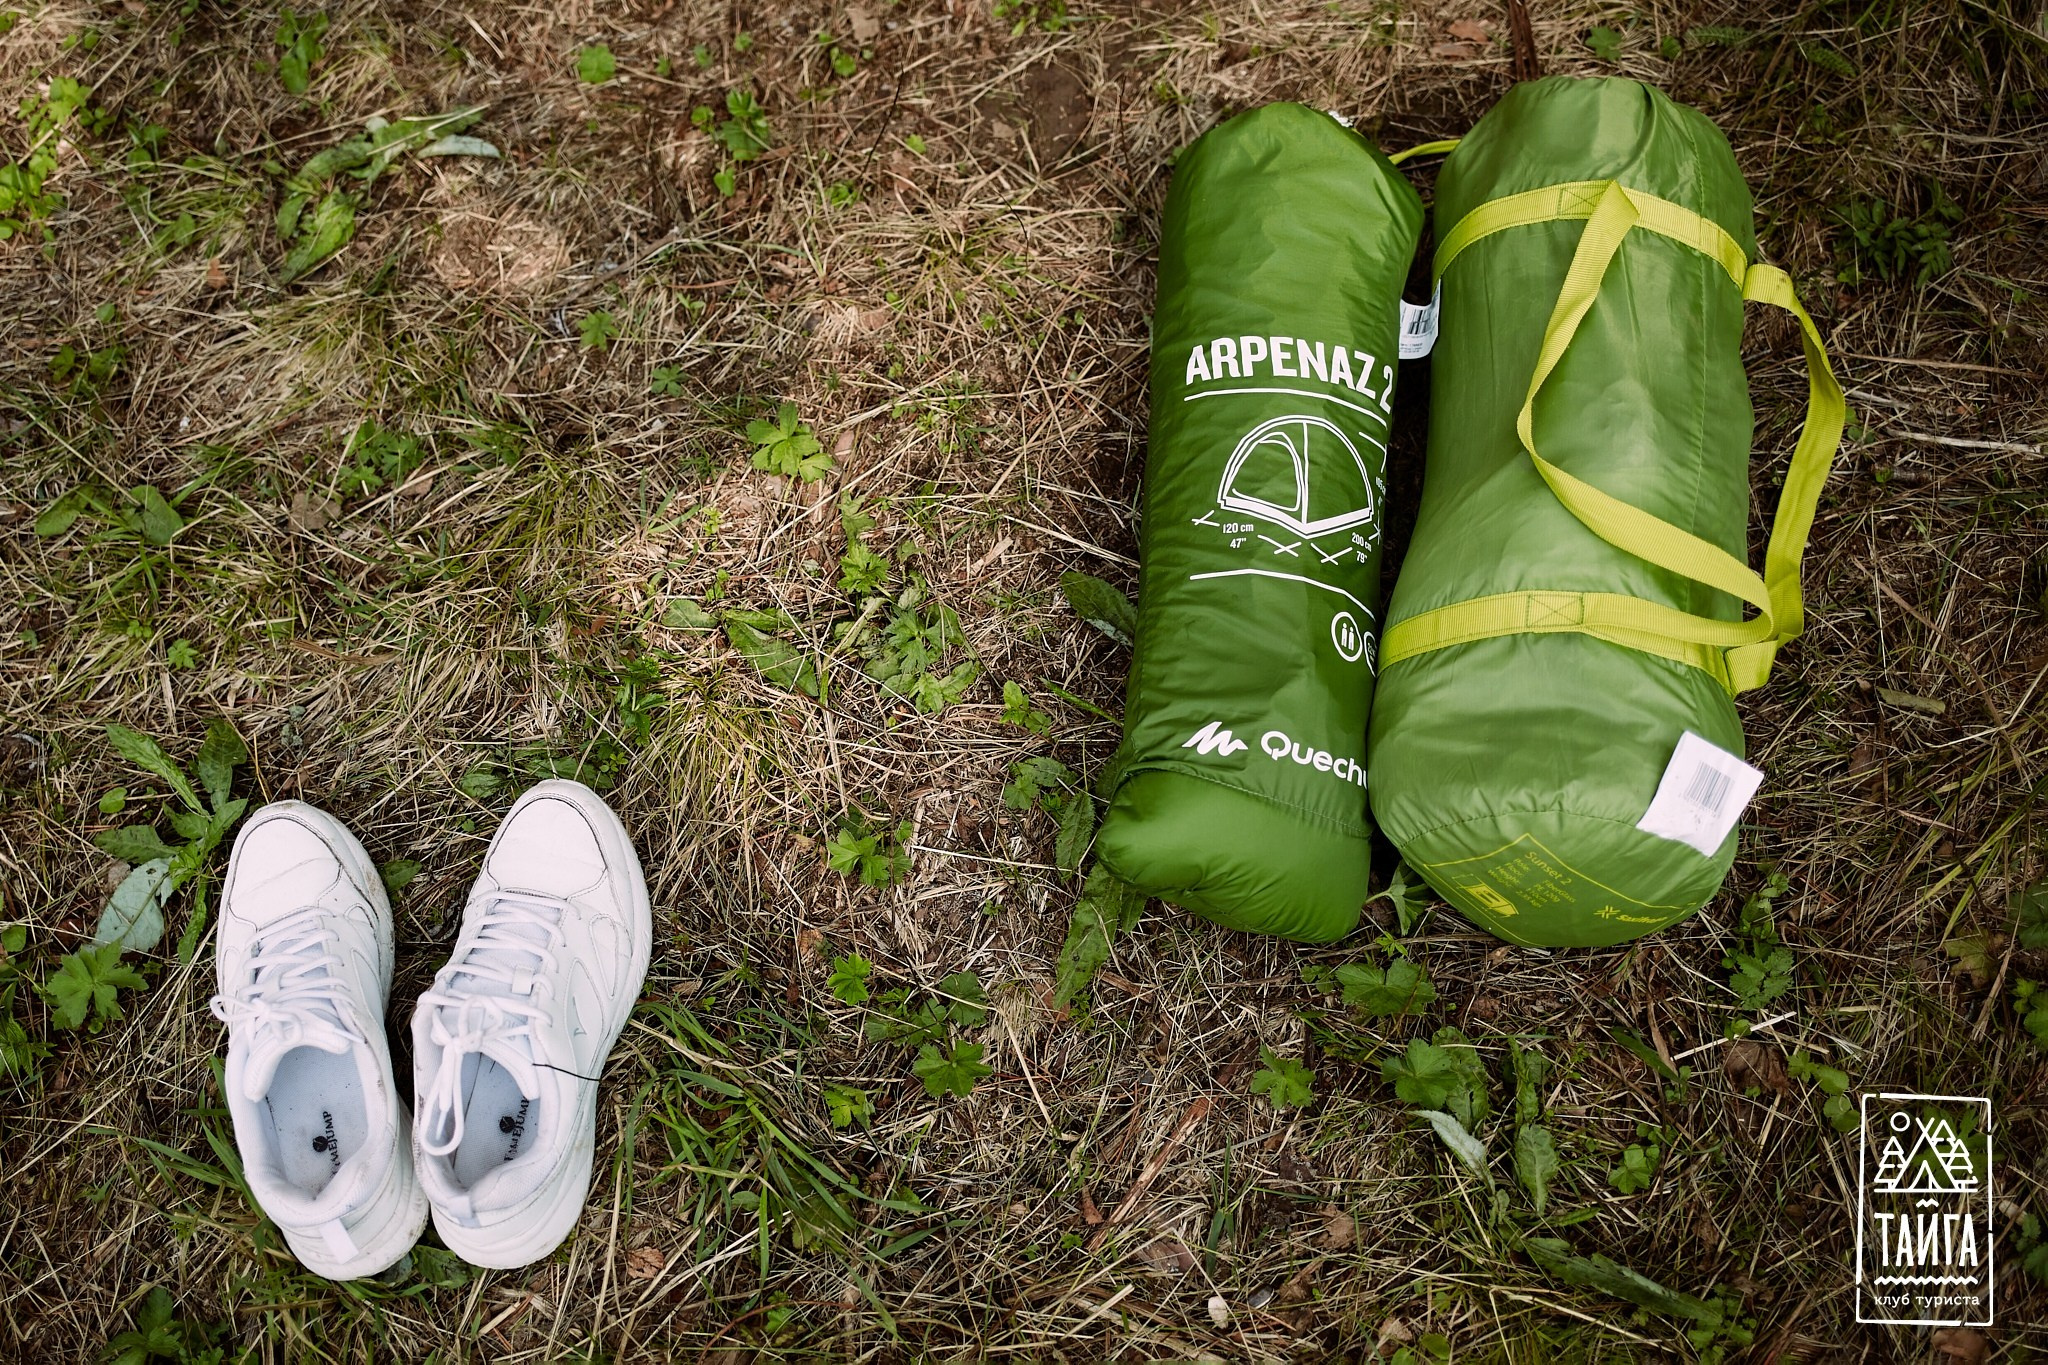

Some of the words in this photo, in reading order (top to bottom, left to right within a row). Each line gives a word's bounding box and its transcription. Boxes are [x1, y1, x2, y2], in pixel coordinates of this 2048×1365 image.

[1185, 335, 1376, 400] ARPENAZ
[1379, 364, 1394, 415] 2
[1222, 523, 1239, 534] 120
[1240, 523, 1254, 533] cm
[1351, 531, 1365, 547] 200
[1524, 851, 1563, 880] Sunset
[1560, 878, 1572, 886] 2
